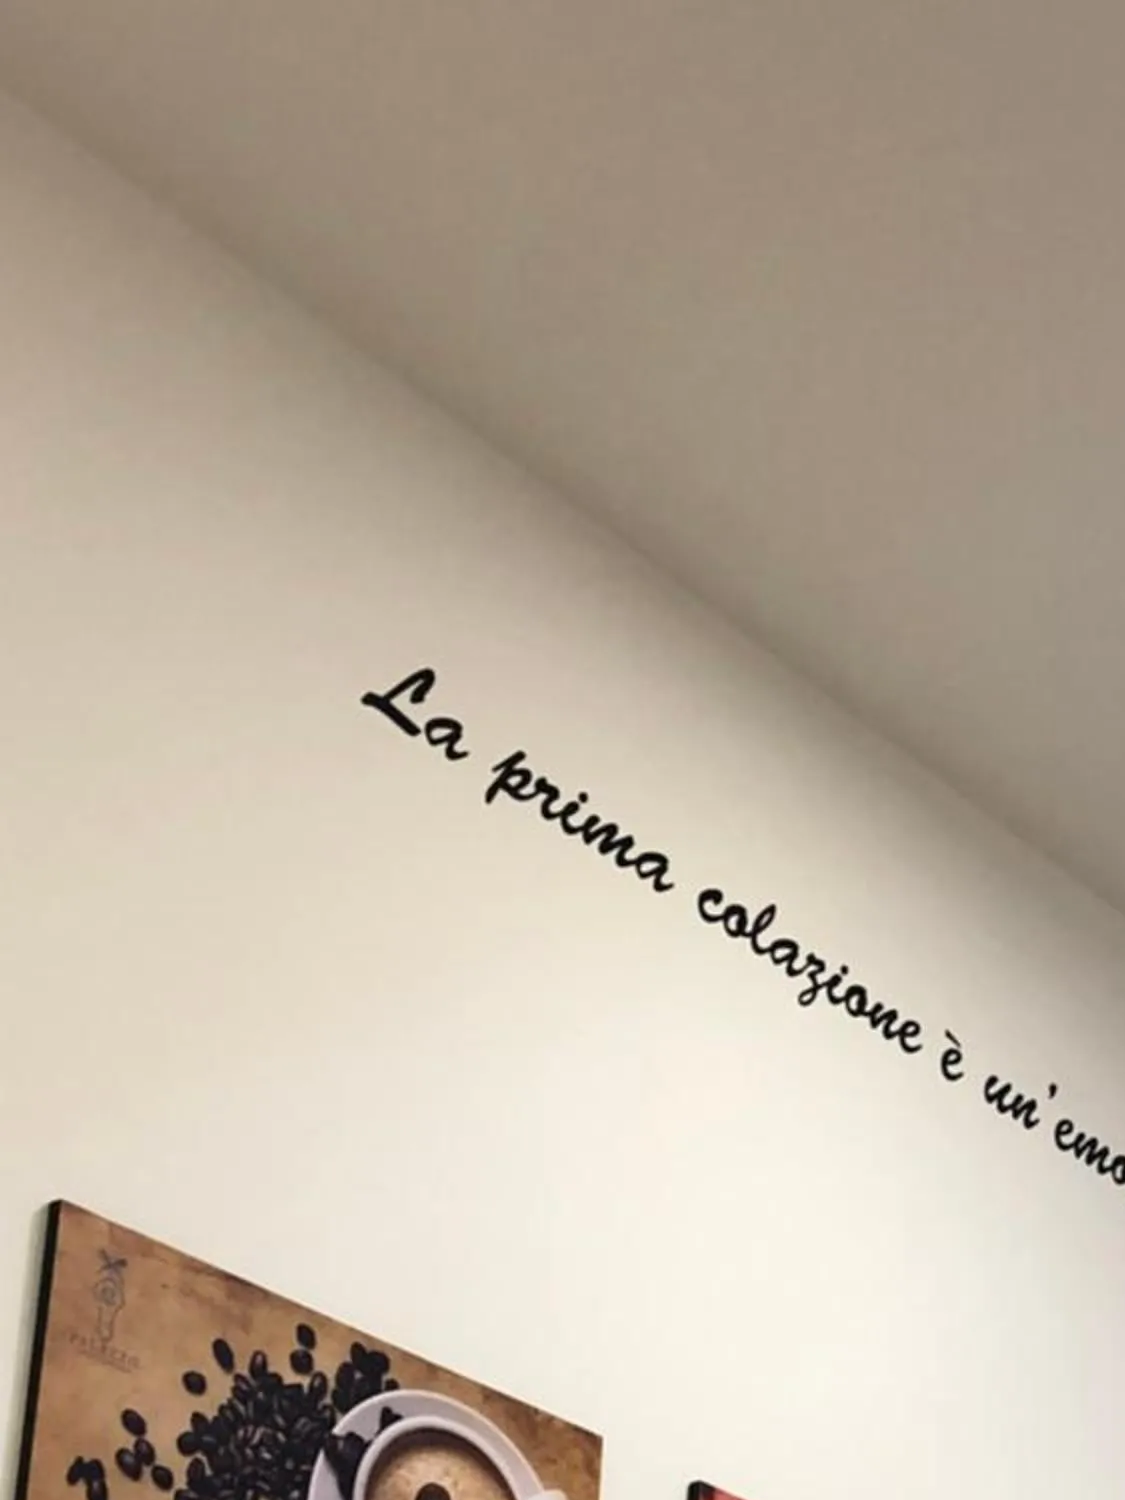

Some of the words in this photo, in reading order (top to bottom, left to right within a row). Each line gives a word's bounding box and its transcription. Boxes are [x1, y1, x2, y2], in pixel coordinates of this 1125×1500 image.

[361, 668, 468, 761] La
[485, 751, 674, 893] prima
[697, 888, 923, 1055] colazione
[940, 1029, 965, 1082] è
